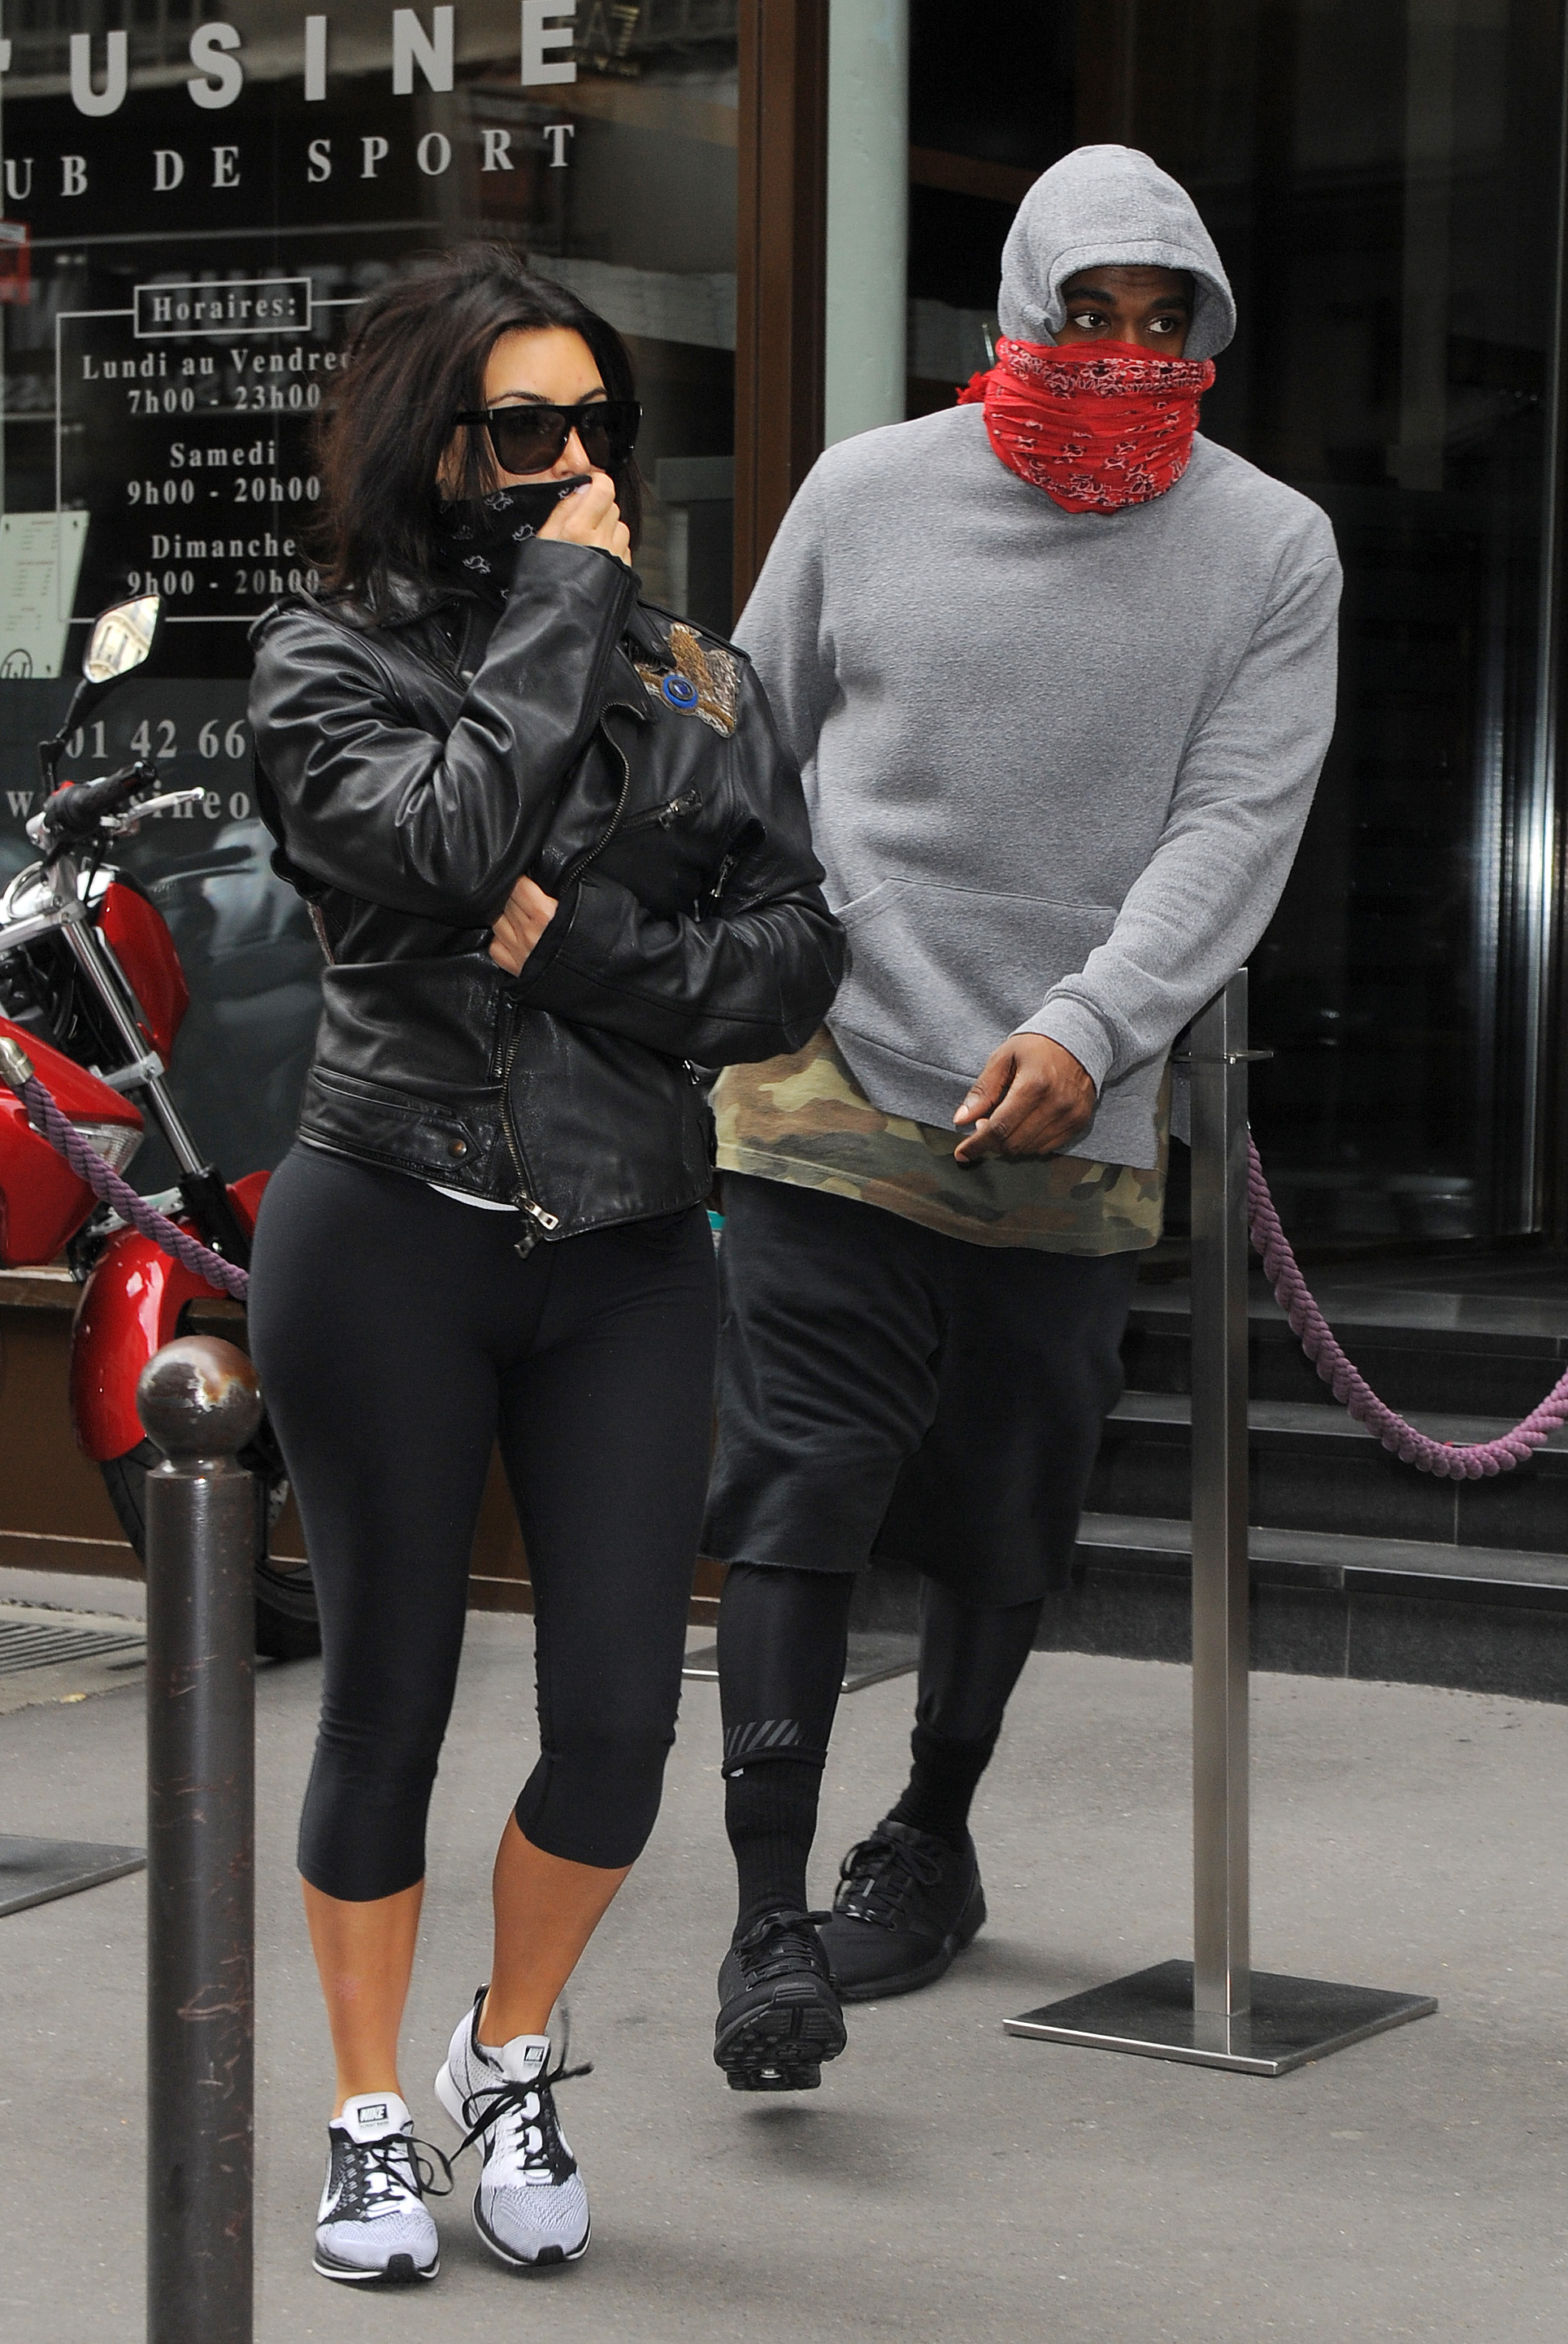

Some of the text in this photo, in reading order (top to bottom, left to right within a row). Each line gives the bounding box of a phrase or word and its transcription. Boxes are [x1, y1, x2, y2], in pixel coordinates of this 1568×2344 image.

[154, 146, 241, 191] DE
[307, 124, 575, 183] SPORT
[153, 294, 296, 322] Horaires:
[83, 352, 167, 380] Lundi
[182, 356, 214, 376] au
[128, 388, 195, 414] 7h00
[234, 383, 321, 410] 23h00
[170, 440, 276, 468] Samedi
[127, 480, 195, 505] 9h00
[234, 476, 320, 502] 20h00
[151, 533, 296, 559] Dimanche
[127, 571, 195, 596] 9h00
[235, 568, 319, 595] 20h00
[65, 719, 246, 759] 01 42 66
